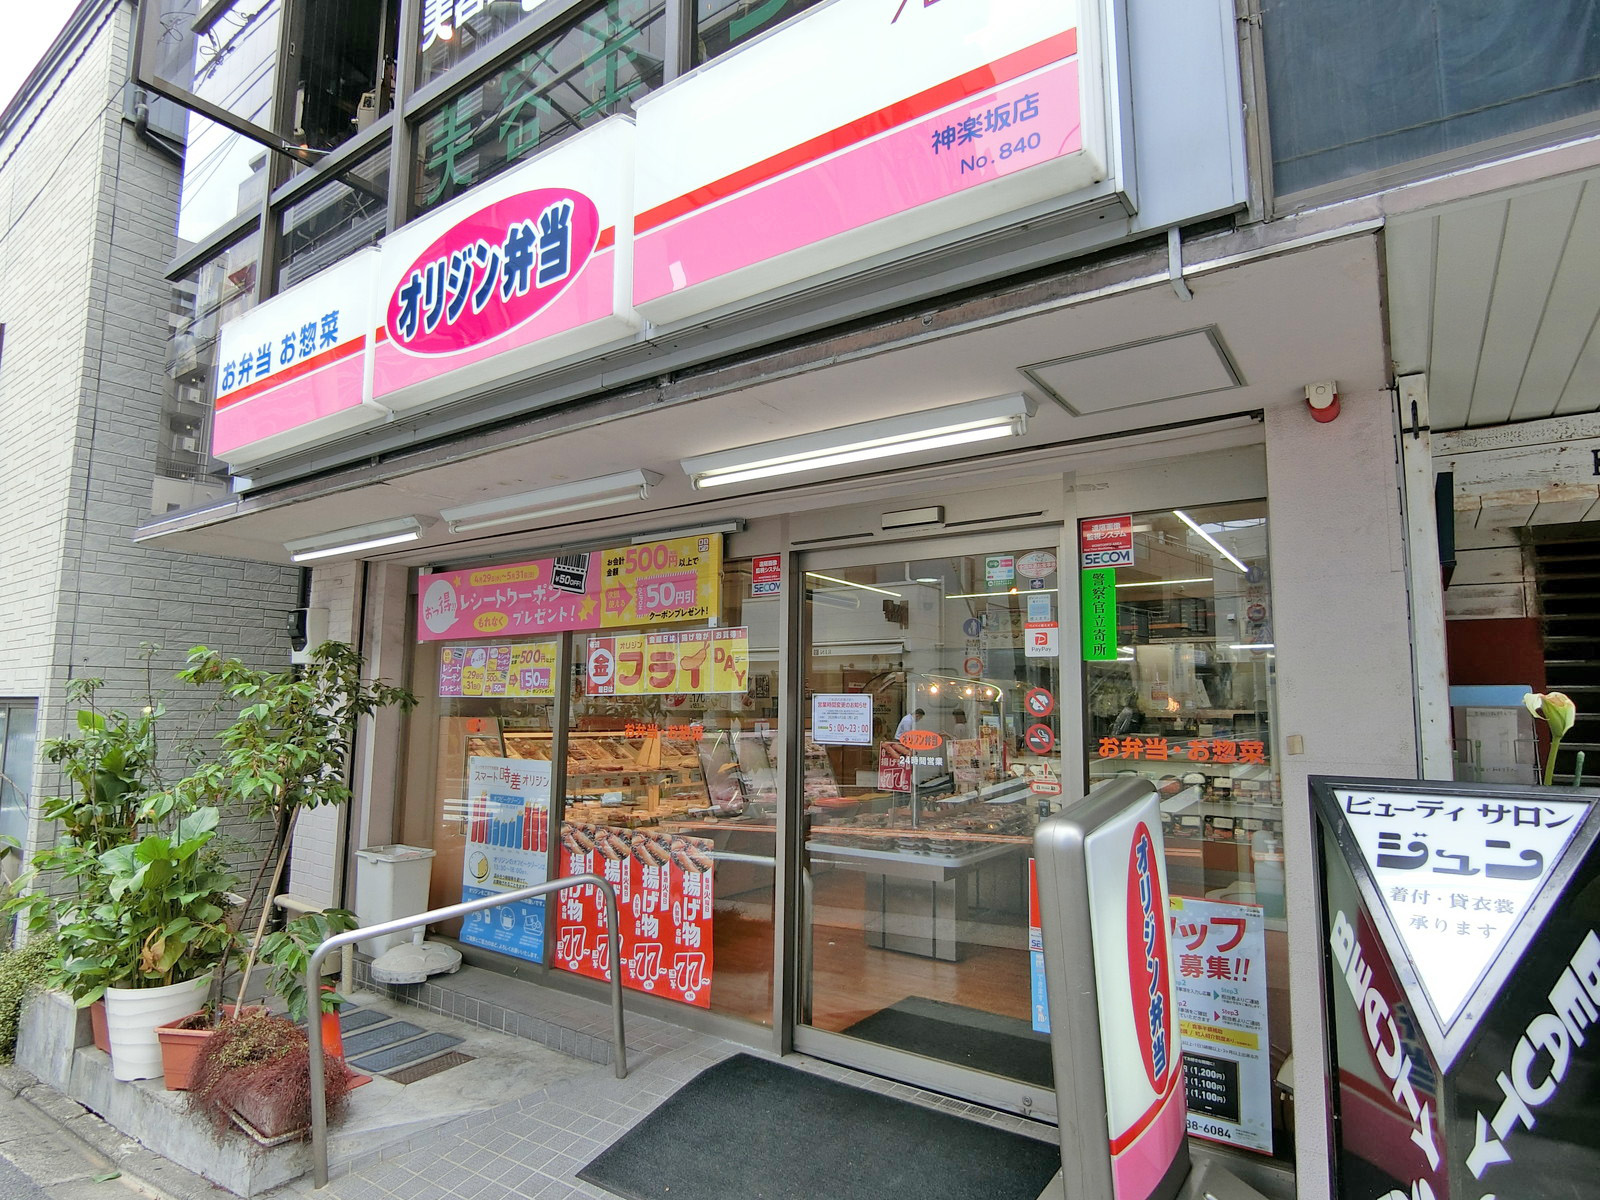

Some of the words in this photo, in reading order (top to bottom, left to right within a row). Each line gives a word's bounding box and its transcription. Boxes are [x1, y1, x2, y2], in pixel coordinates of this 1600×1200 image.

[931, 92, 1040, 155] 神楽坂店
[399, 202, 573, 340] オリジン弁当
[222, 342, 272, 392] お弁当
[280, 310, 340, 364] お惣菜
[1085, 551, 1130, 564] SECOM
[461, 584, 562, 610] レシートクーポン
[646, 582, 694, 608] 50円引
[513, 605, 576, 626] プレゼント!
[1092, 573, 1107, 656] 警察官立寄所
[619, 641, 643, 650] オリジン
[441, 674, 461, 682] クーポン
[443, 664, 461, 672] レシート
[592, 653, 610, 677] 金
[900, 755, 943, 766] 24時間営業
[1098, 737, 1265, 764] お弁当・お惣菜
[1346, 796, 1464, 821] ビューティ
[1477, 803, 1574, 828] サロン
[1377, 831, 1543, 880] ジュン
[642, 864, 659, 938] 揚げ物
[682, 870, 700, 948] 揚げ物
[1390, 886, 1514, 914] 着付・貸衣裳
[1171, 917, 1246, 952] ッフ
[1409, 914, 1496, 939] 承ります
[1136, 835, 1168, 1081] オリジン弁当
[1180, 954, 1250, 982] 募集!!
[1330, 910, 1440, 1172] BEAUTY
